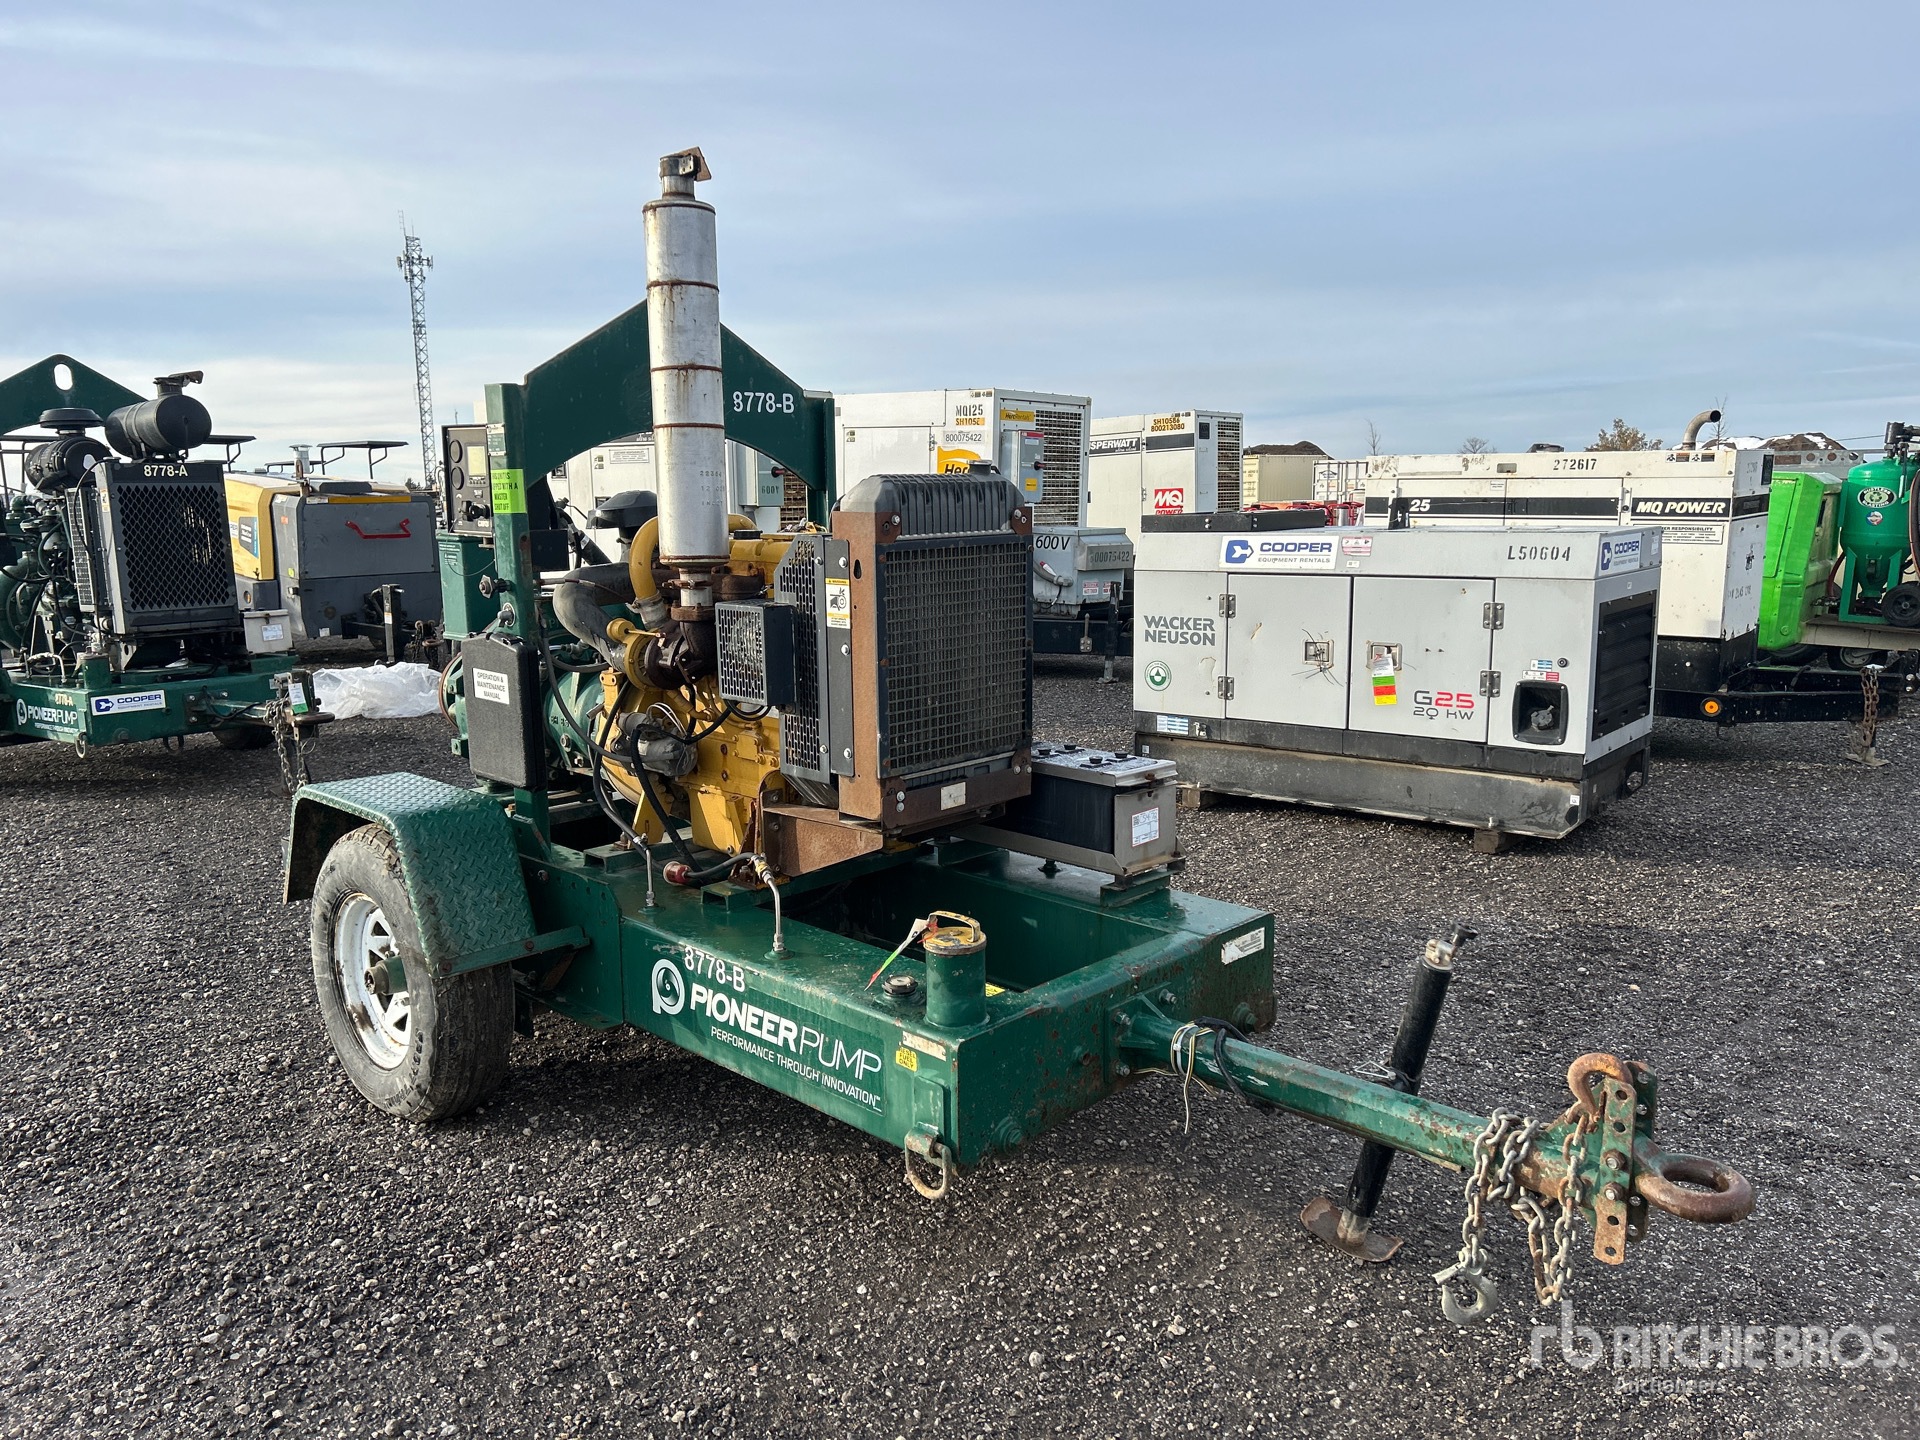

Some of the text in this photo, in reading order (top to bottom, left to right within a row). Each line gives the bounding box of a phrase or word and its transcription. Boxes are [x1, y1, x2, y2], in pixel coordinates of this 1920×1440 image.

[733, 391, 794, 413] 8778-B
[1151, 423, 1184, 432] 800213080
[945, 433, 982, 442] 800075422
[144, 464, 188, 477] 8778-A
[1553, 458, 1597, 470] 272617
[1155, 490, 1183, 506] MQ
[1409, 499, 1431, 512] 25
[1636, 501, 1726, 515] MQ POWER
[1260, 542, 1332, 553] COOPER
[1508, 545, 1571, 561] L50604
[1615, 541, 1639, 554] COOPER
[1144, 615, 1215, 631] WACKER
[1144, 629, 1215, 646] NEUSON
[477, 672, 500, 682] OPERATION
[477, 681, 505, 692] MAINTENANCE
[117, 694, 162, 703] COOPER
[484, 691, 501, 700] MANUAL
[1414, 690, 1475, 709] G25
[684, 946, 746, 993] 8778-B
[711, 1026, 775, 1063] PERFORMANCE
[776, 1053, 820, 1083] THROUGH
[899, 1052, 913, 1062] FUEL
[899, 1058, 914, 1068] ONLY
